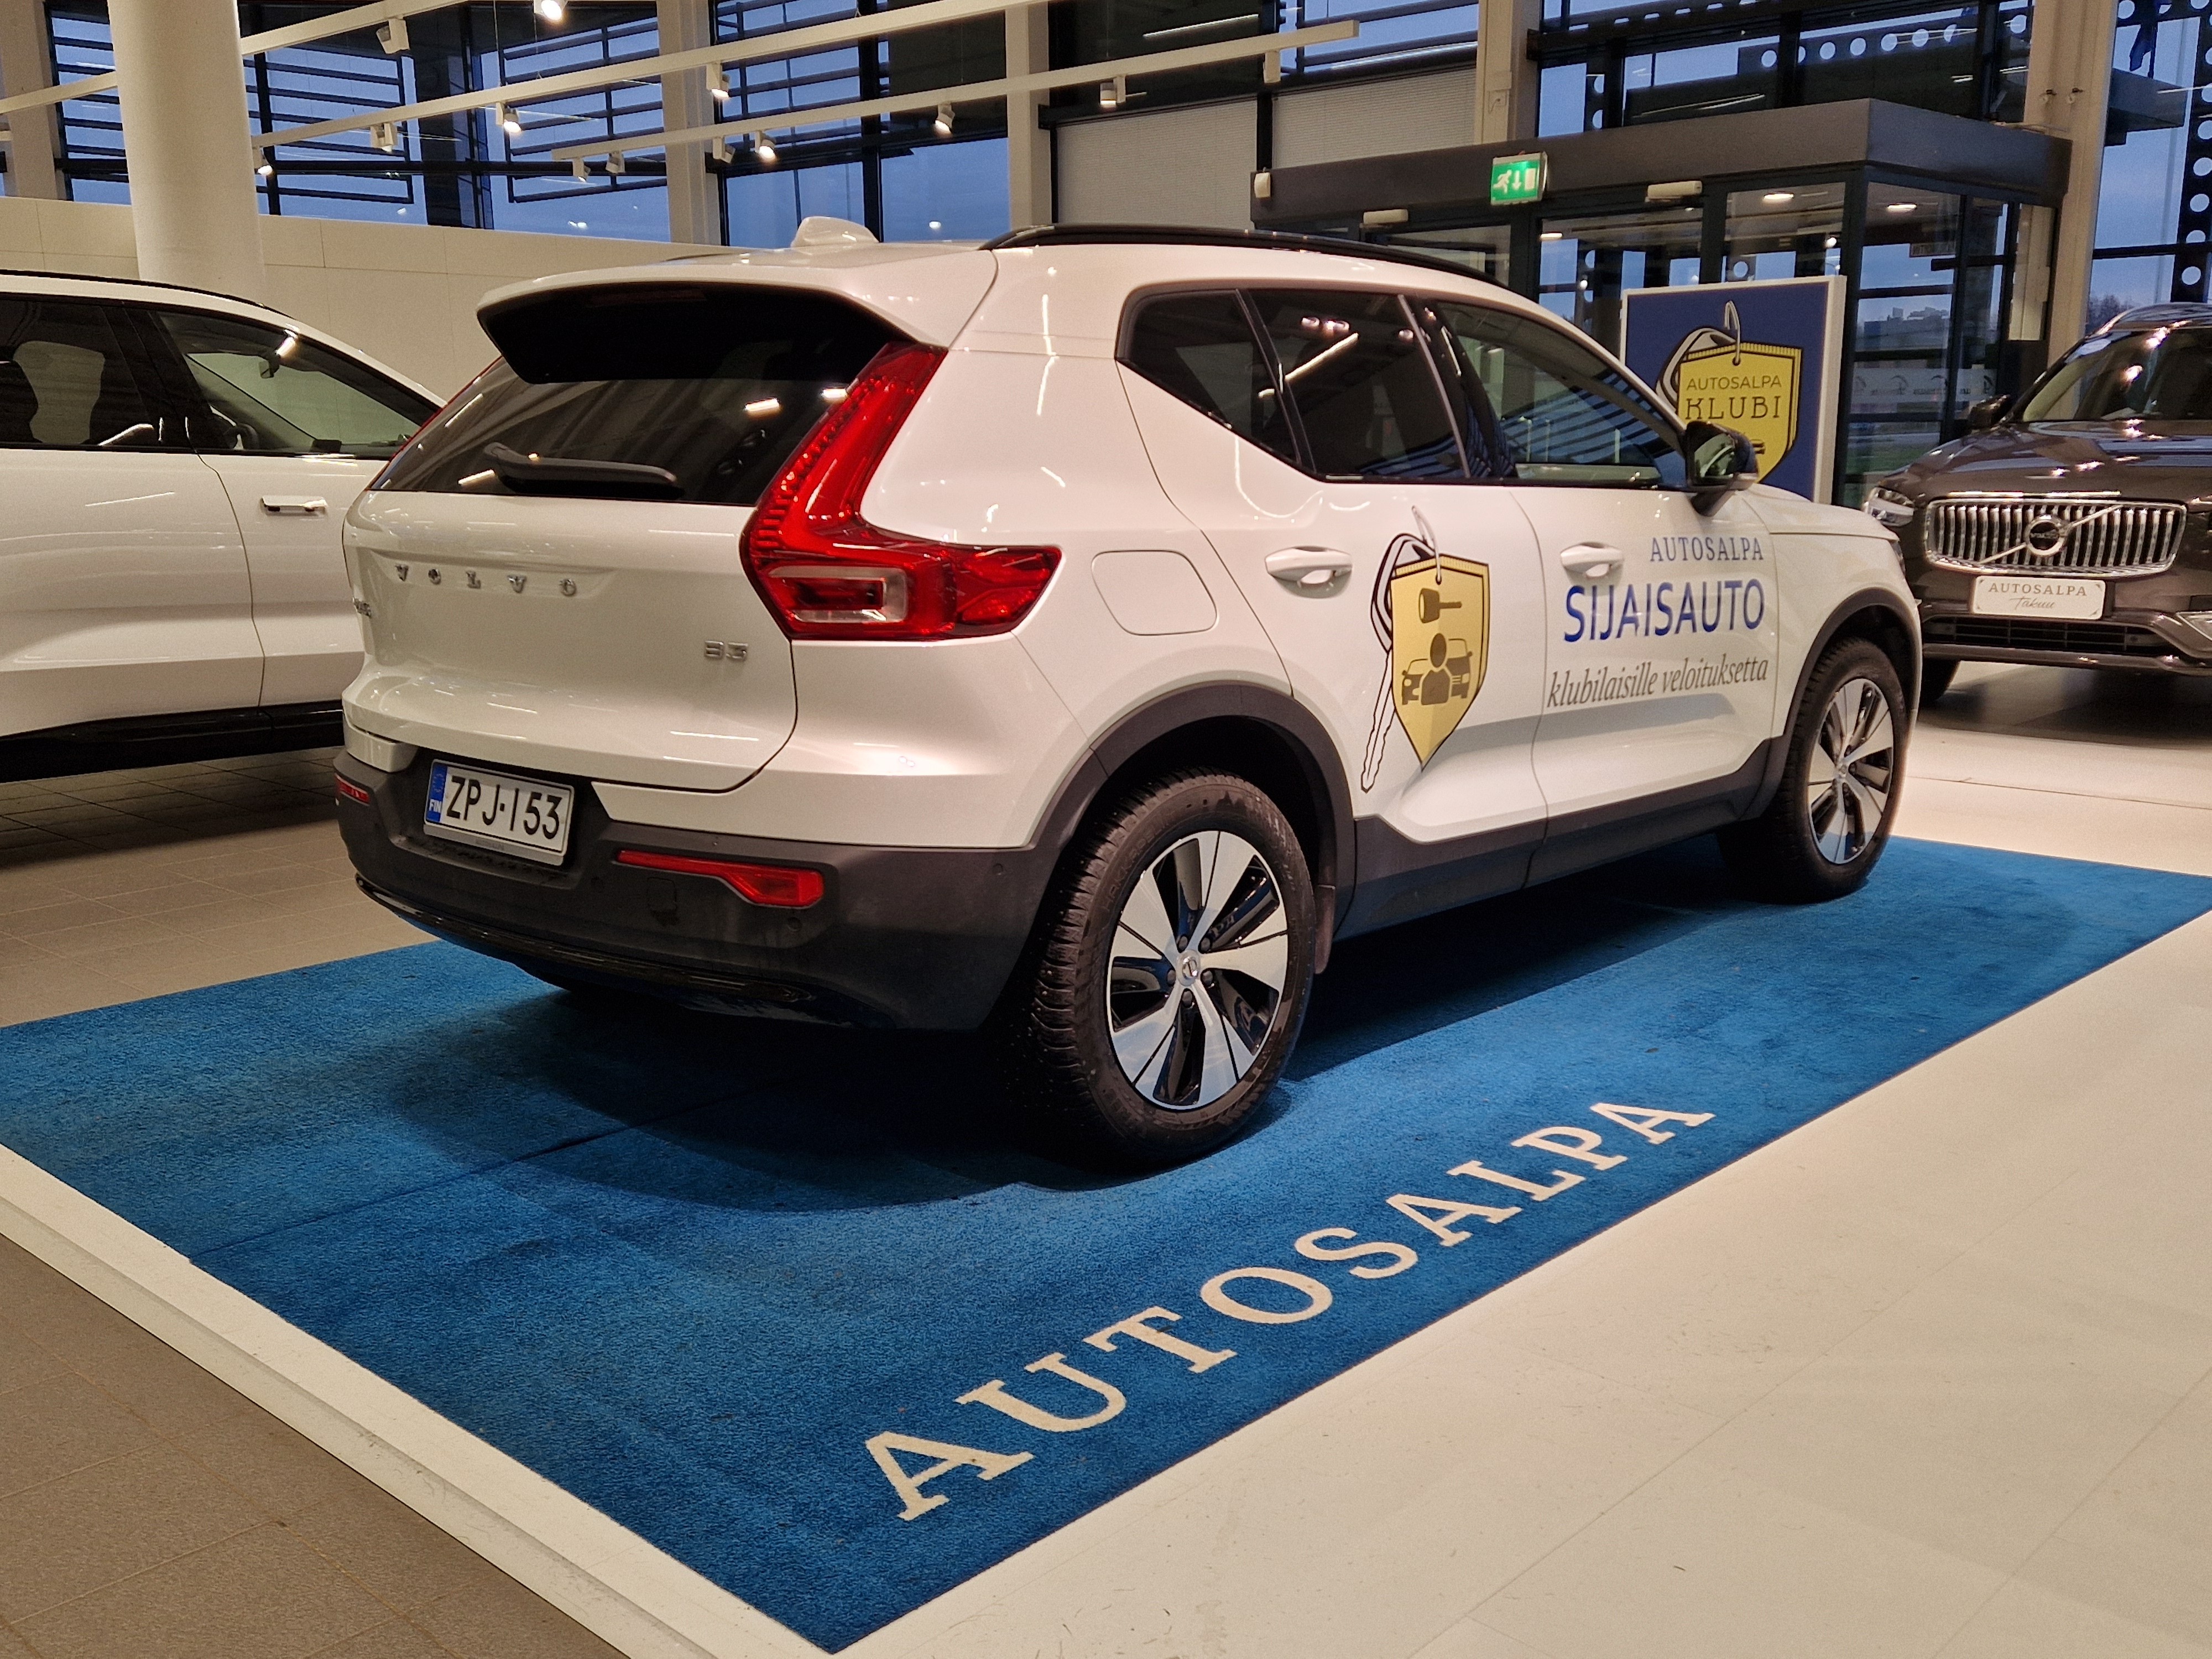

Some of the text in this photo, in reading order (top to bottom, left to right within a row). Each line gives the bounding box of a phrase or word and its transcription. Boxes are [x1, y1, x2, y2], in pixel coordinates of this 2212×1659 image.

[1687, 375, 1782, 390] AUTOSALPA
[1685, 395, 1782, 420] KLUBI
[1650, 536, 1764, 561] AUTOSALPA
[395, 564, 577, 596] VOLVO
[1988, 582, 2088, 596] AUTOSALPA
[1563, 578, 1765, 643] SIJAISAUTO
[2008, 596, 2056, 610] Takuu
[1547, 653, 1769, 708] klubilaisille veloituksetta
[429, 799, 442, 812] FIN
[865, 1102, 1714, 1521] AUTOSALPA
